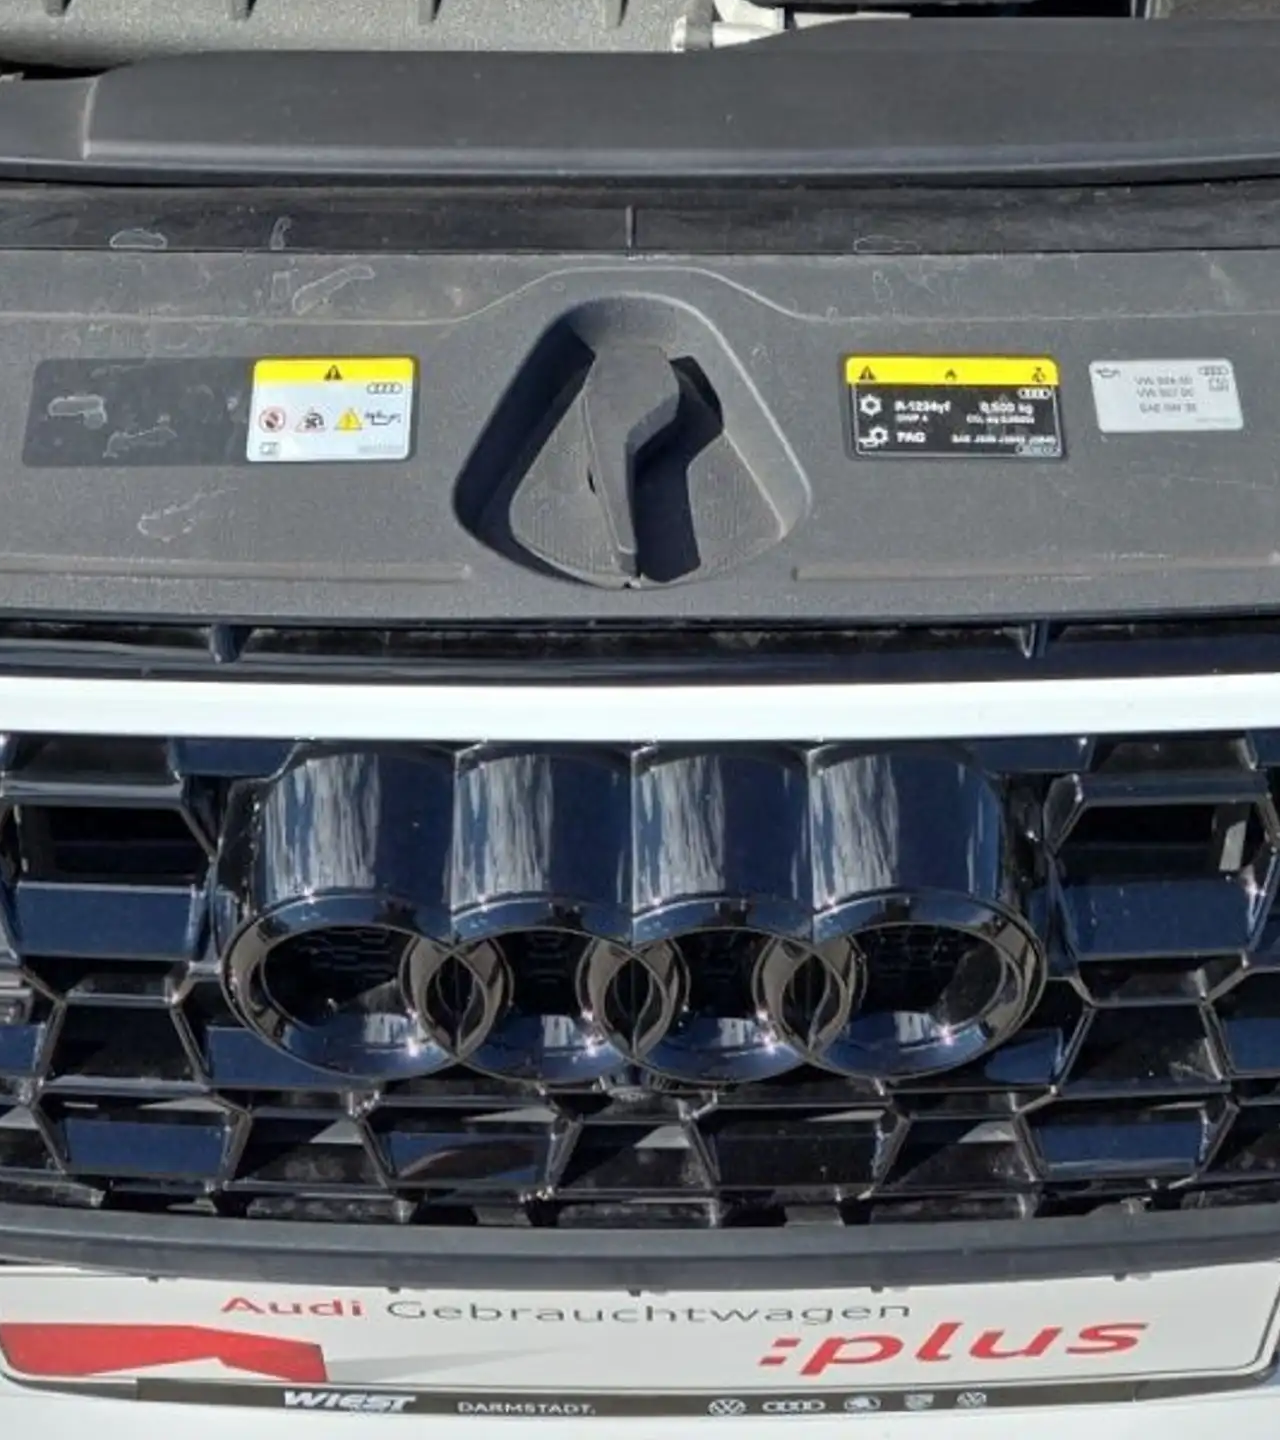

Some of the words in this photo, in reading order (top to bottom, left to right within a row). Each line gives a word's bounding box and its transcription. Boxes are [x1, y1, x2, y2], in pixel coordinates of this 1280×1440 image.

[221, 1295, 363, 1317] Audi
[387, 1300, 911, 1326] Gebrauchtwagen
[284, 1389, 417, 1414] WIEST
